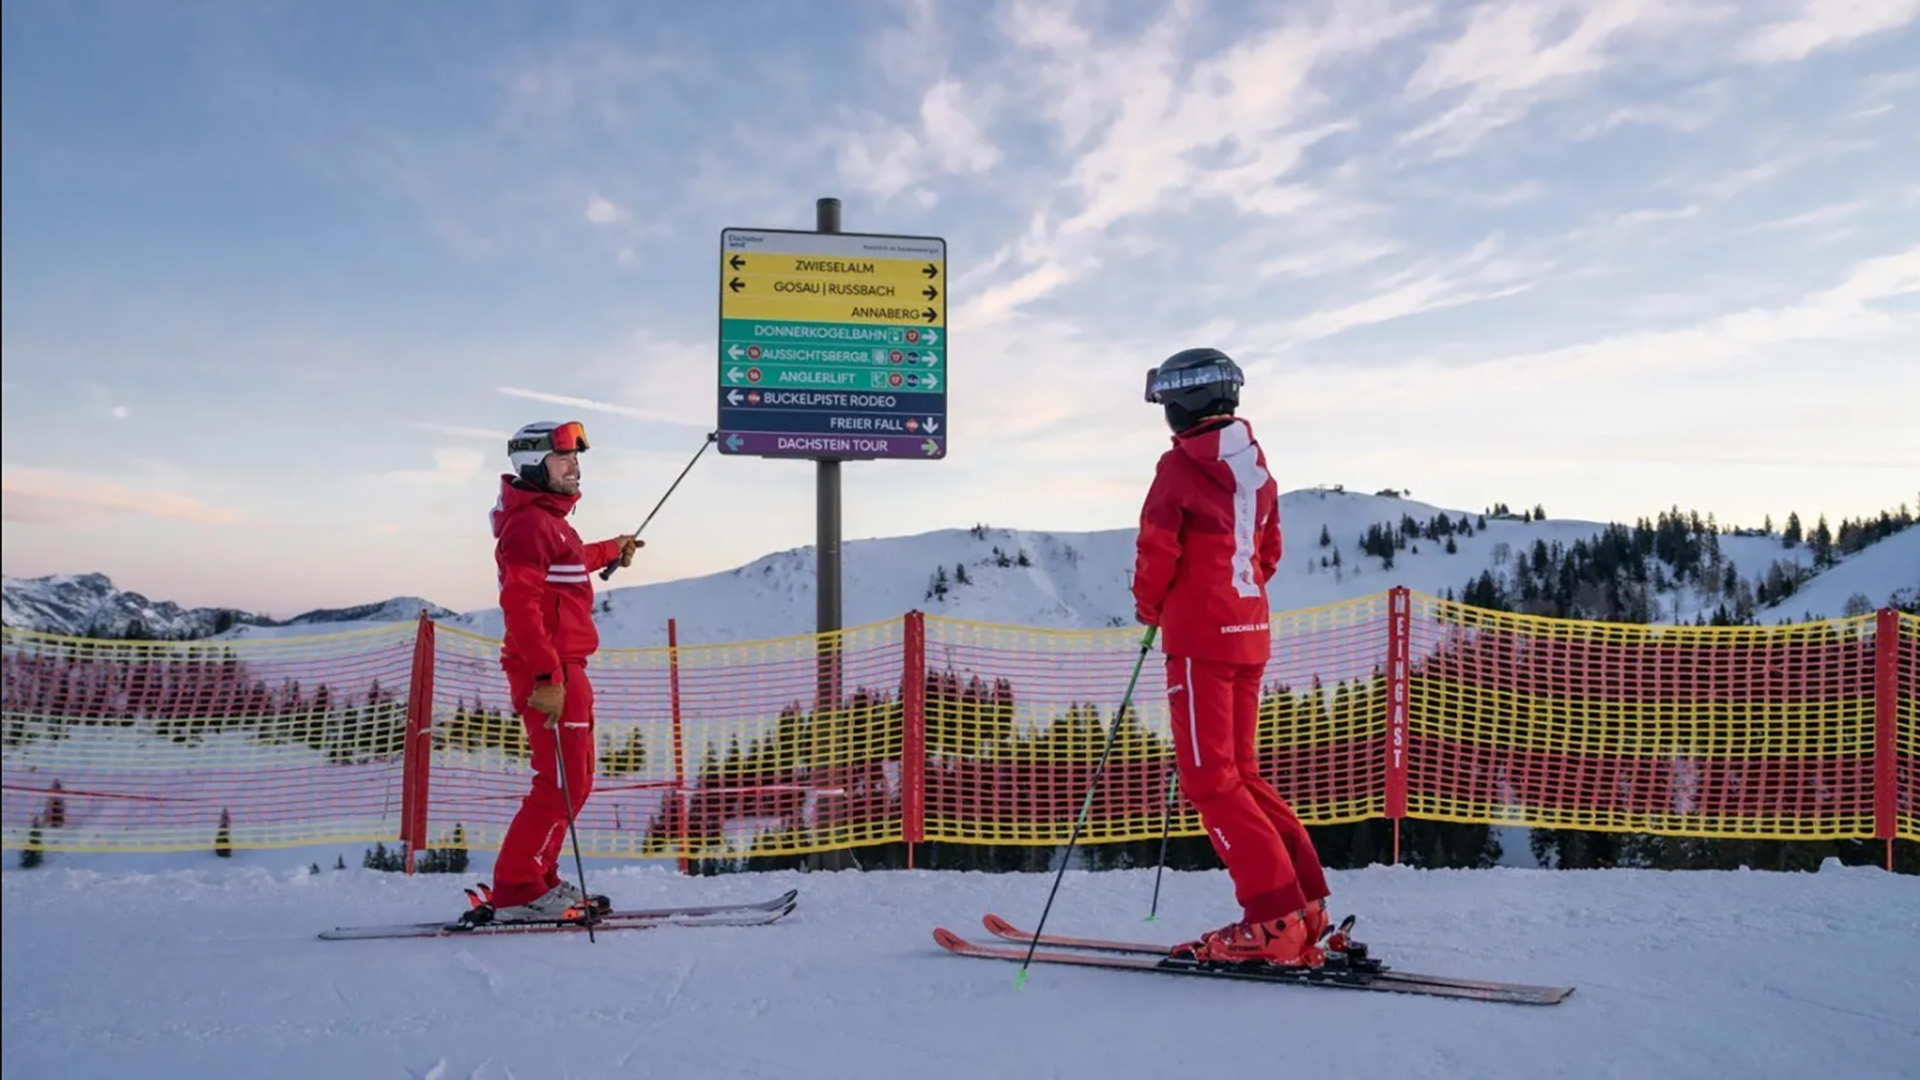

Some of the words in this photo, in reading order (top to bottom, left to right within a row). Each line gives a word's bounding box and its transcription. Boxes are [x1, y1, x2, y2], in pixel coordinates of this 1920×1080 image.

[795, 260, 874, 274] ZWIESELALM
[773, 281, 820, 293] GOSAU
[828, 283, 895, 297] RUSSBACH
[851, 307, 920, 320] ANNABERG
[754, 324, 887, 340] DONNERKOGELBAHN
[779, 371, 856, 384] ANGLERLIFT
[763, 392, 848, 406] BUCKELPISTE
[849, 395, 896, 407] RODEO
[830, 417, 872, 430] FREIER
[874, 418, 904, 431] FALL
[777, 437, 851, 451] DACHSTEIN
[852, 440, 889, 452] TOUR
[1393, 594, 1406, 769] MEINGAST
